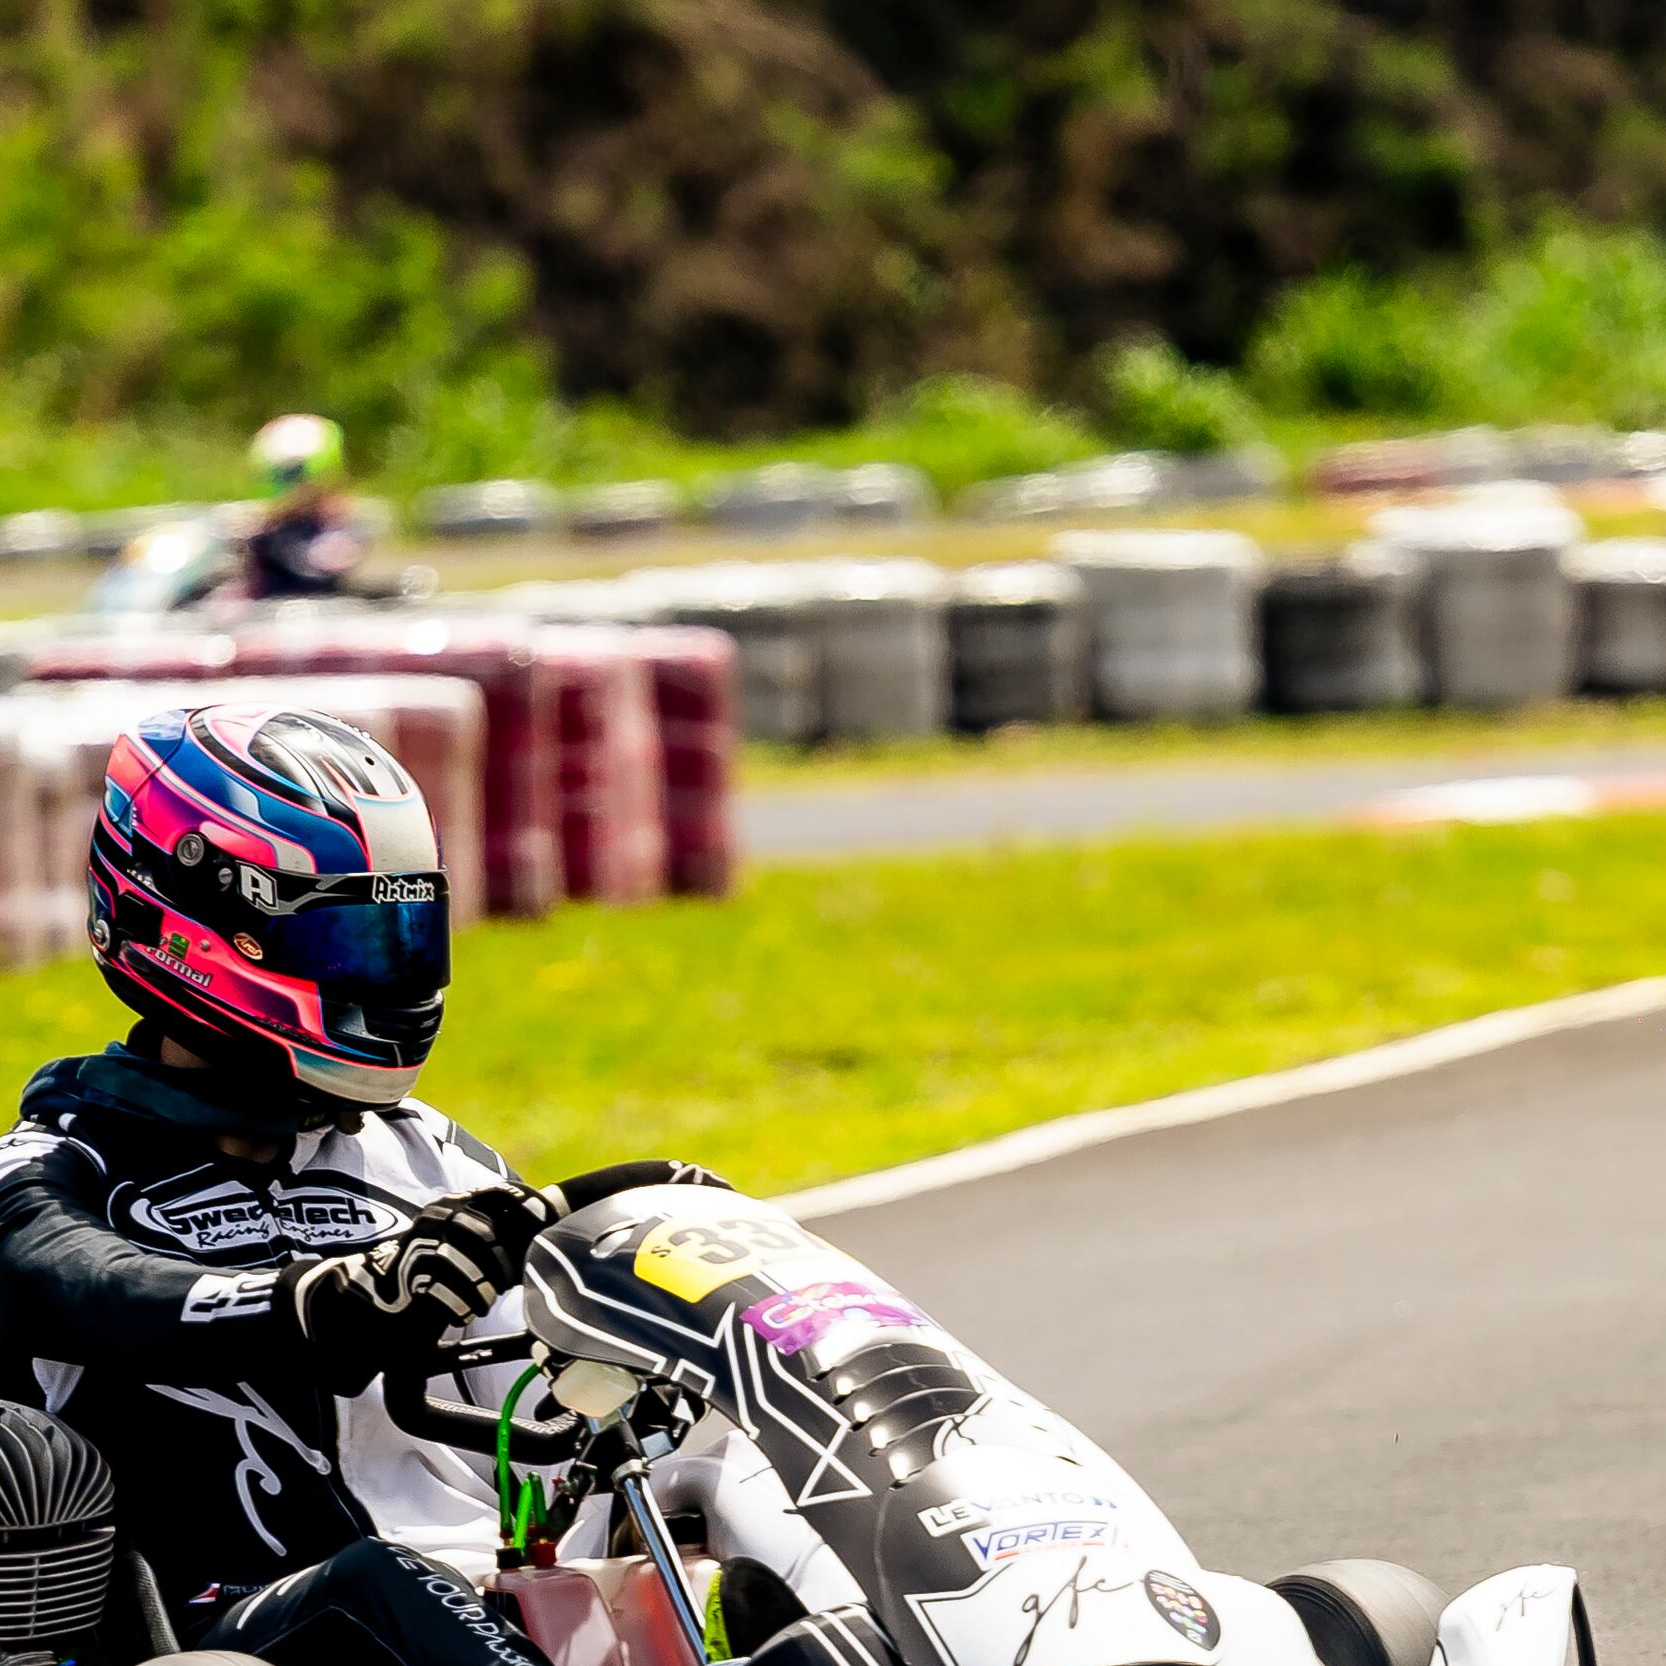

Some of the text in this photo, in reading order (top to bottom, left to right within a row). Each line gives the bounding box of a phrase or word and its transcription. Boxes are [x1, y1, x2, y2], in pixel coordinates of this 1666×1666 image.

[372, 875, 435, 904] Artmix
[196, 1221, 270, 1249] Racing
[417, 1573, 487, 1621] YOUR
